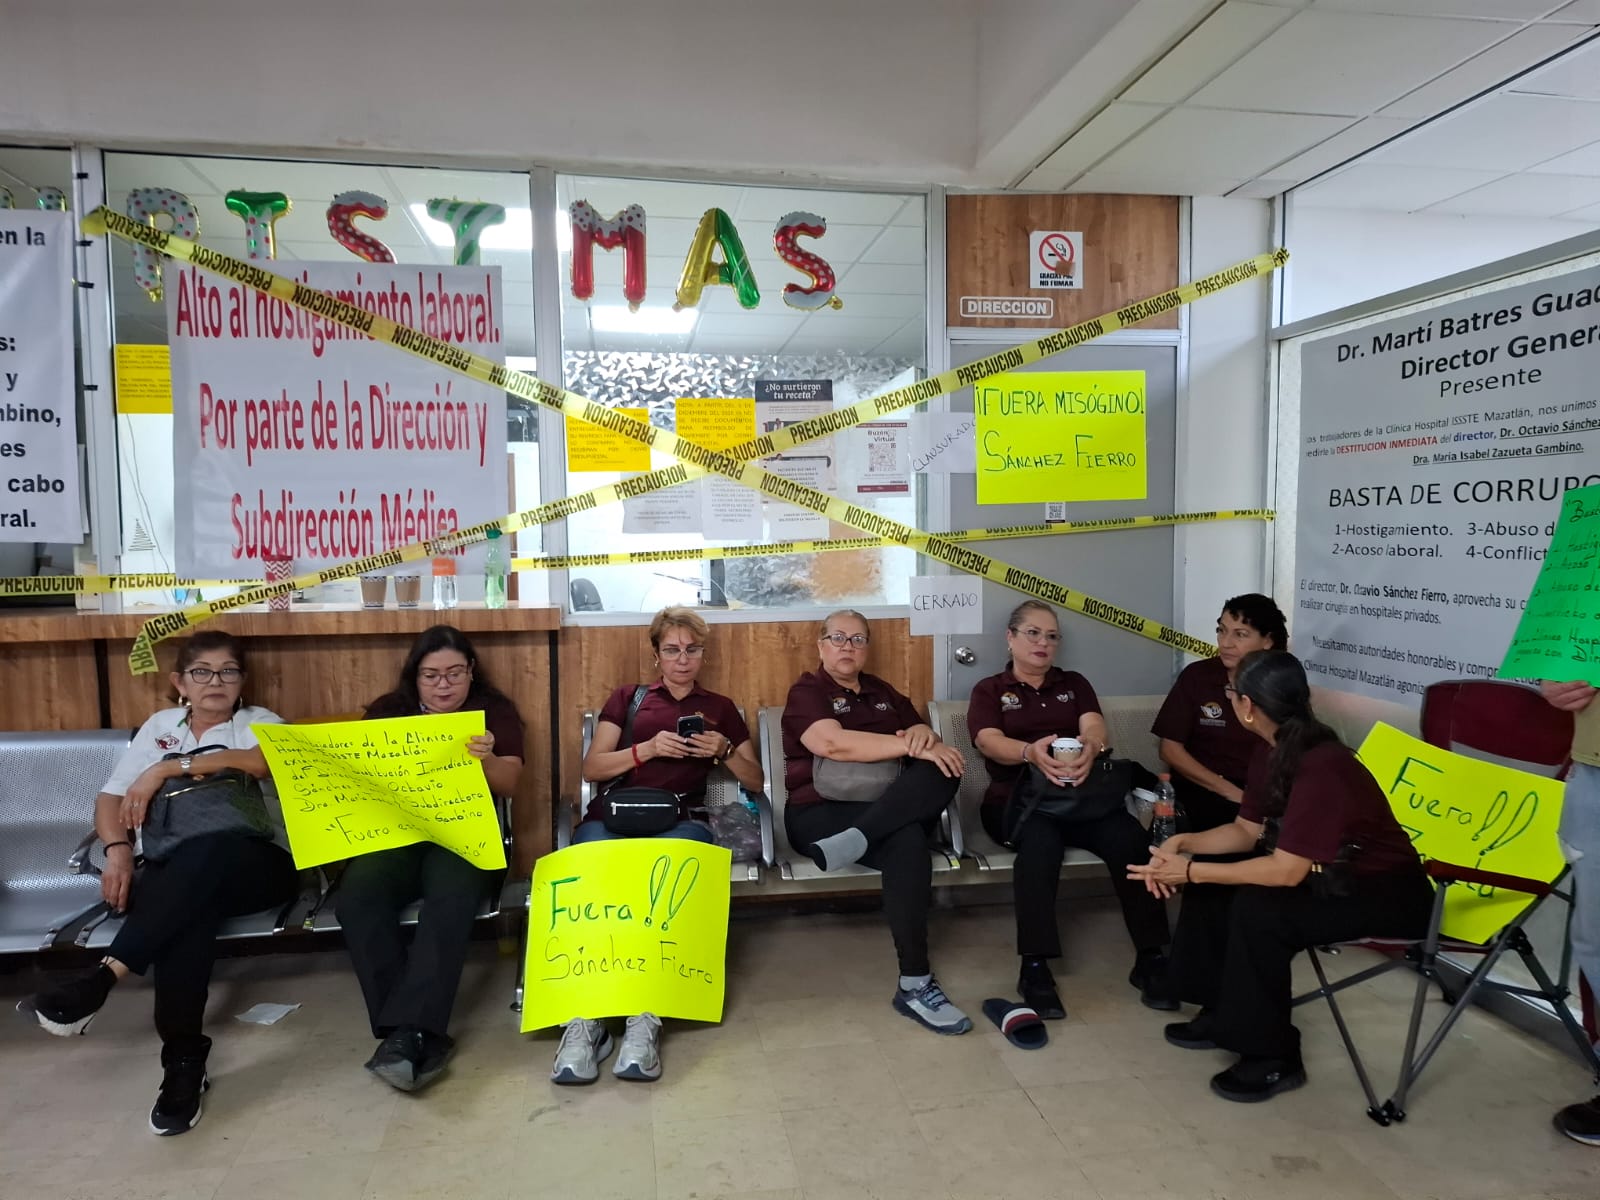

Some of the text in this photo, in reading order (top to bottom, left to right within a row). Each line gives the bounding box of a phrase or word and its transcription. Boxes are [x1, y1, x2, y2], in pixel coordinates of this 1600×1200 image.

[26, 226, 46, 246] la
[568, 198, 843, 312] MAS
[176, 265, 222, 338] Alto
[229, 284, 249, 338] al
[418, 271, 500, 343] laboral.
[967, 301, 1047, 315] DIRECCION
[1337, 343, 1365, 362] Dr.
[1372, 321, 1433, 354] Martí
[1439, 305, 1522, 338] Batres
[1401, 324, 1600, 379] Director Gener
[6, 373, 18, 391] y
[765, 382, 821, 393] ¿No surtieron
[1440, 368, 1542, 397] Presente
[773, 390, 817, 400] tu receta?
[0, 403, 61, 427] bino,
[200, 382, 238, 449] Por
[245, 388, 304, 467] parte
[311, 379, 338, 450] de
[344, 379, 363, 450] la
[369, 380, 470, 450] Dirección
[475, 402, 488, 467] y
[1363, 427, 1374, 437] de
[1376, 426, 1383, 435] la
[1414, 416, 1449, 431] Hospital
[1484, 407, 1534, 422] Mazatlán,
[1538, 405, 1558, 416] nos
[1561, 399, 1597, 412] unimos
[189, 245, 273, 290] PRECAUCION
[291, 284, 374, 333] PRECAUCION
[391, 325, 472, 372] PRECAUCION
[488, 364, 567, 410] PRECAUCION
[582, 402, 658, 446] PRECAUCION
[673, 438, 746, 480] PRECAUCION
[760, 472, 830, 513] PRECAUCION
[844, 505, 912, 545] PRECAUCION
[925, 536, 992, 575] PRECAUCION
[1004, 567, 1069, 604] PRECAUCION
[1082, 597, 1145, 632] PRECAUCION
[209, 581, 297, 613] PRECAUCION
[319, 550, 403, 584] PRECAUCION
[520, 492, 598, 528] PRECAUCION
[614, 463, 688, 500] PRECAUCION
[789, 406, 860, 444] PRECAUCION
[874, 377, 942, 415] PRECAUCION
[956, 348, 1024, 387] PRECAUCION
[1037, 319, 1104, 357] PRECAUCION
[1117, 290, 1182, 327] PRECAUCION
[1195, 260, 1258, 297] PRECAUCION
[1389, 435, 1438, 449] INMEDIATA
[1453, 430, 1497, 443] director,
[1500, 427, 1516, 438] Dr.
[1518, 422, 1560, 436] Octavio
[0, 443, 26, 457] es
[1413, 455, 1430, 465] Dra.
[1460, 448, 1490, 460] Isabel
[1491, 447, 1533, 458] Zazueta
[1535, 441, 1585, 455] Gambino.
[8, 474, 65, 493] cabo
[1329, 485, 1402, 507] BASTA
[1410, 483, 1442, 505] DE
[0, 509, 36, 528] ral.
[231, 488, 374, 560] Subdirección
[1467, 522, 1539, 537] 3-Abuso
[1386, 544, 1443, 558] laboral.
[1466, 545, 1548, 561] 4-Conflict
[913, 592, 978, 612] CERRADO
[1340, 582, 1352, 595] Dr.
[1383, 585, 1418, 600] Sánchez
[1421, 588, 1449, 605] Fierro,
[1453, 593, 1501, 609] aprovecha
[1505, 598, 1516, 609] su
[1349, 605, 1359, 615] en
[1360, 603, 1402, 621] hospitales
[1404, 609, 1441, 624] privados.
[1407, 650, 1457, 671] honorables
[1458, 662, 1464, 675] y
[541, 934, 712, 984] Sánchez Fierro
